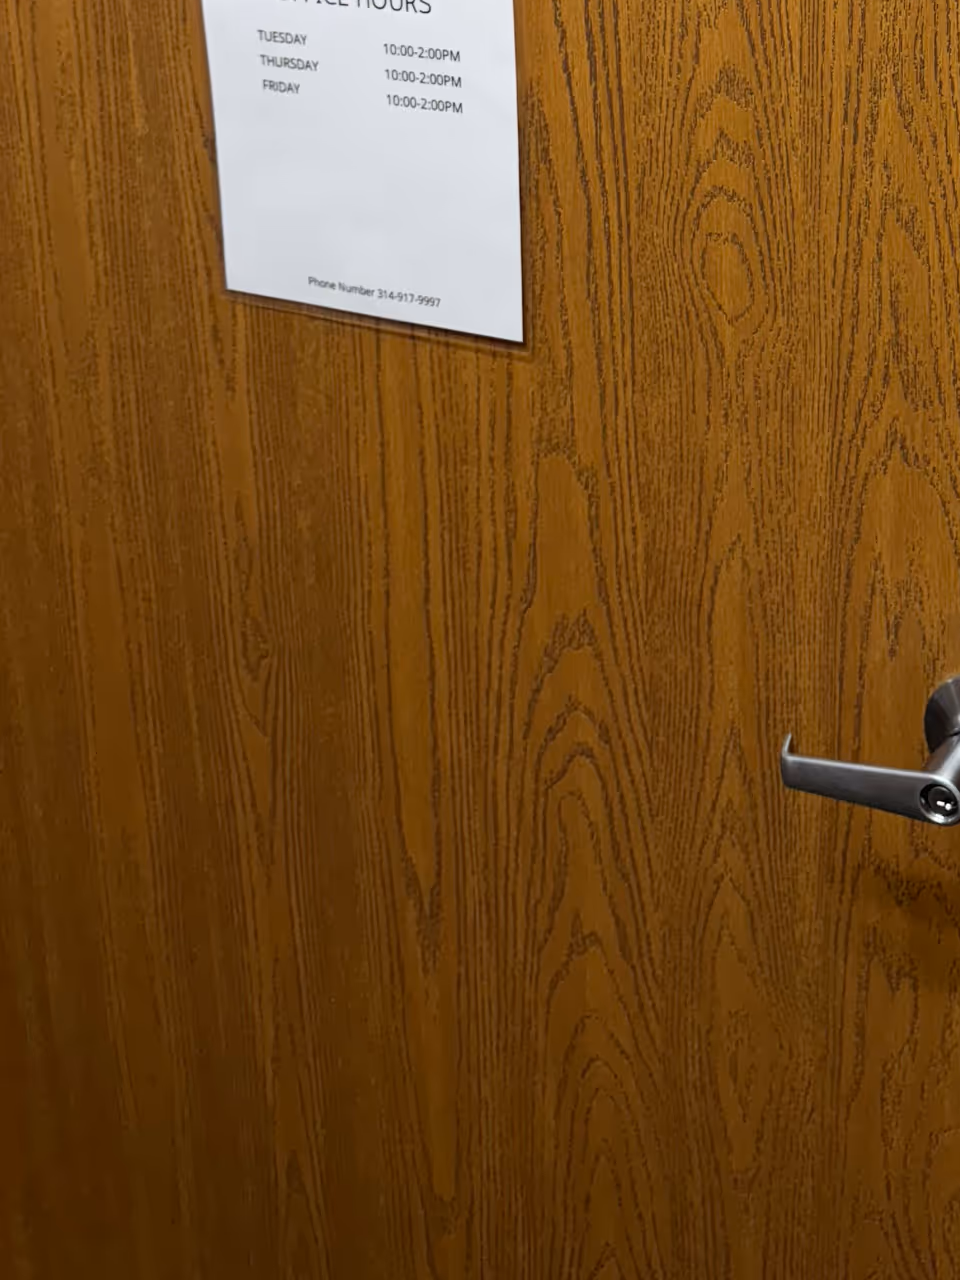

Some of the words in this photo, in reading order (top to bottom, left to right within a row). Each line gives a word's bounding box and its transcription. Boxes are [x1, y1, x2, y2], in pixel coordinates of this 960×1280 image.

[257, 29, 307, 45] TUESDAY
[384, 43, 461, 62] 10:00-2:00PM
[260, 54, 319, 71] THURSDAY
[385, 69, 462, 88] 10:00-2:00PM
[262, 79, 300, 94] FRIDAY
[386, 94, 463, 114] 10:00-2:00PM
[308, 276, 336, 290] Phone
[338, 282, 375, 297] Number
[378, 288, 441, 308] 314-917-9997
